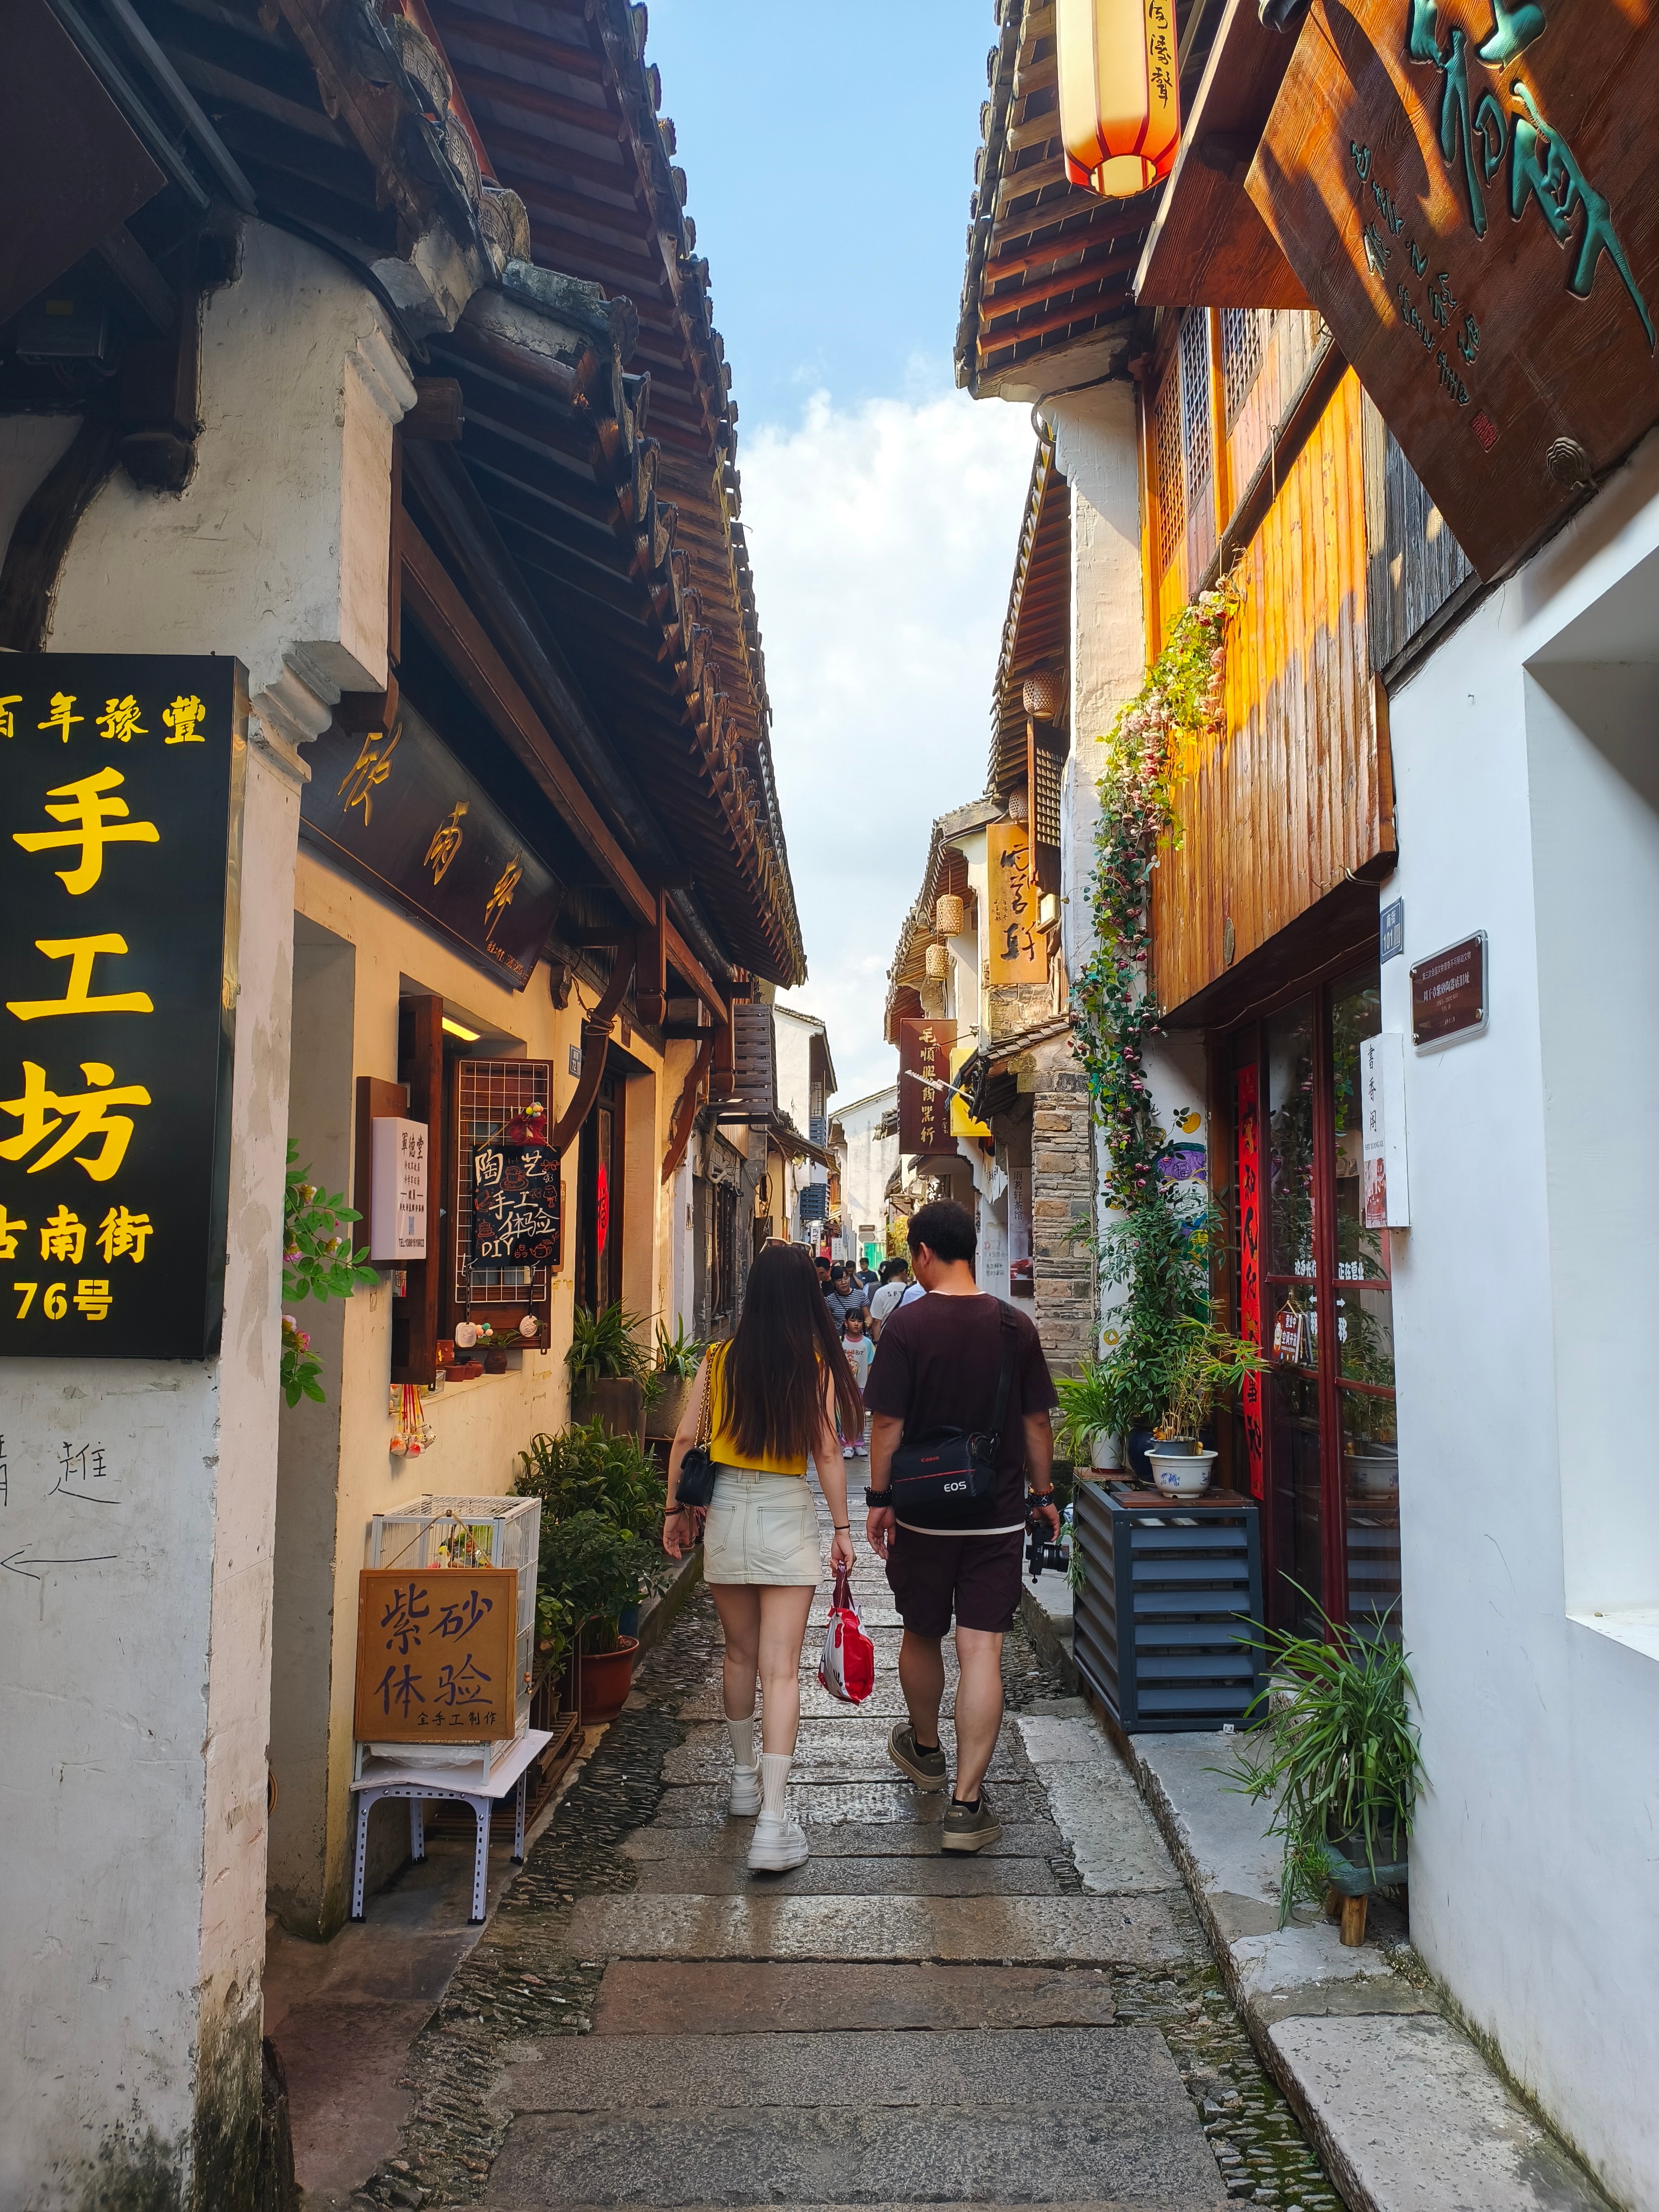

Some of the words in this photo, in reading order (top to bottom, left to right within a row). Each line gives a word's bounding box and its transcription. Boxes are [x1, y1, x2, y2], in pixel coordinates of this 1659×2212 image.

[1386, 909, 1397, 929] 南街
[1383, 929, 1394, 952] 101
[0, 766, 160, 1182] 手工坊
[475, 1149, 547, 1186] 陶艺
[1174, 1164, 1190, 1179] 福
[488, 1190, 538, 1220] 手工
[1013, 1171, 1024, 1220] 雨茗轩茶馆
[498, 1208, 560, 1241] 体验
[482, 1237, 514, 1258] DIY
[1338, 1260, 1365, 1280] 正在营业
[14, 1279, 113, 1320] 76号
[1285, 1314, 1297, 1329] 营业中
[1281, 1330, 1297, 1347] 空调开放
[943, 1481, 967, 1492] EOS
[380, 1583, 493, 1655] 紫砂
[373, 1654, 493, 1719] 体验
[417, 1711, 497, 1726] 全手工制作
